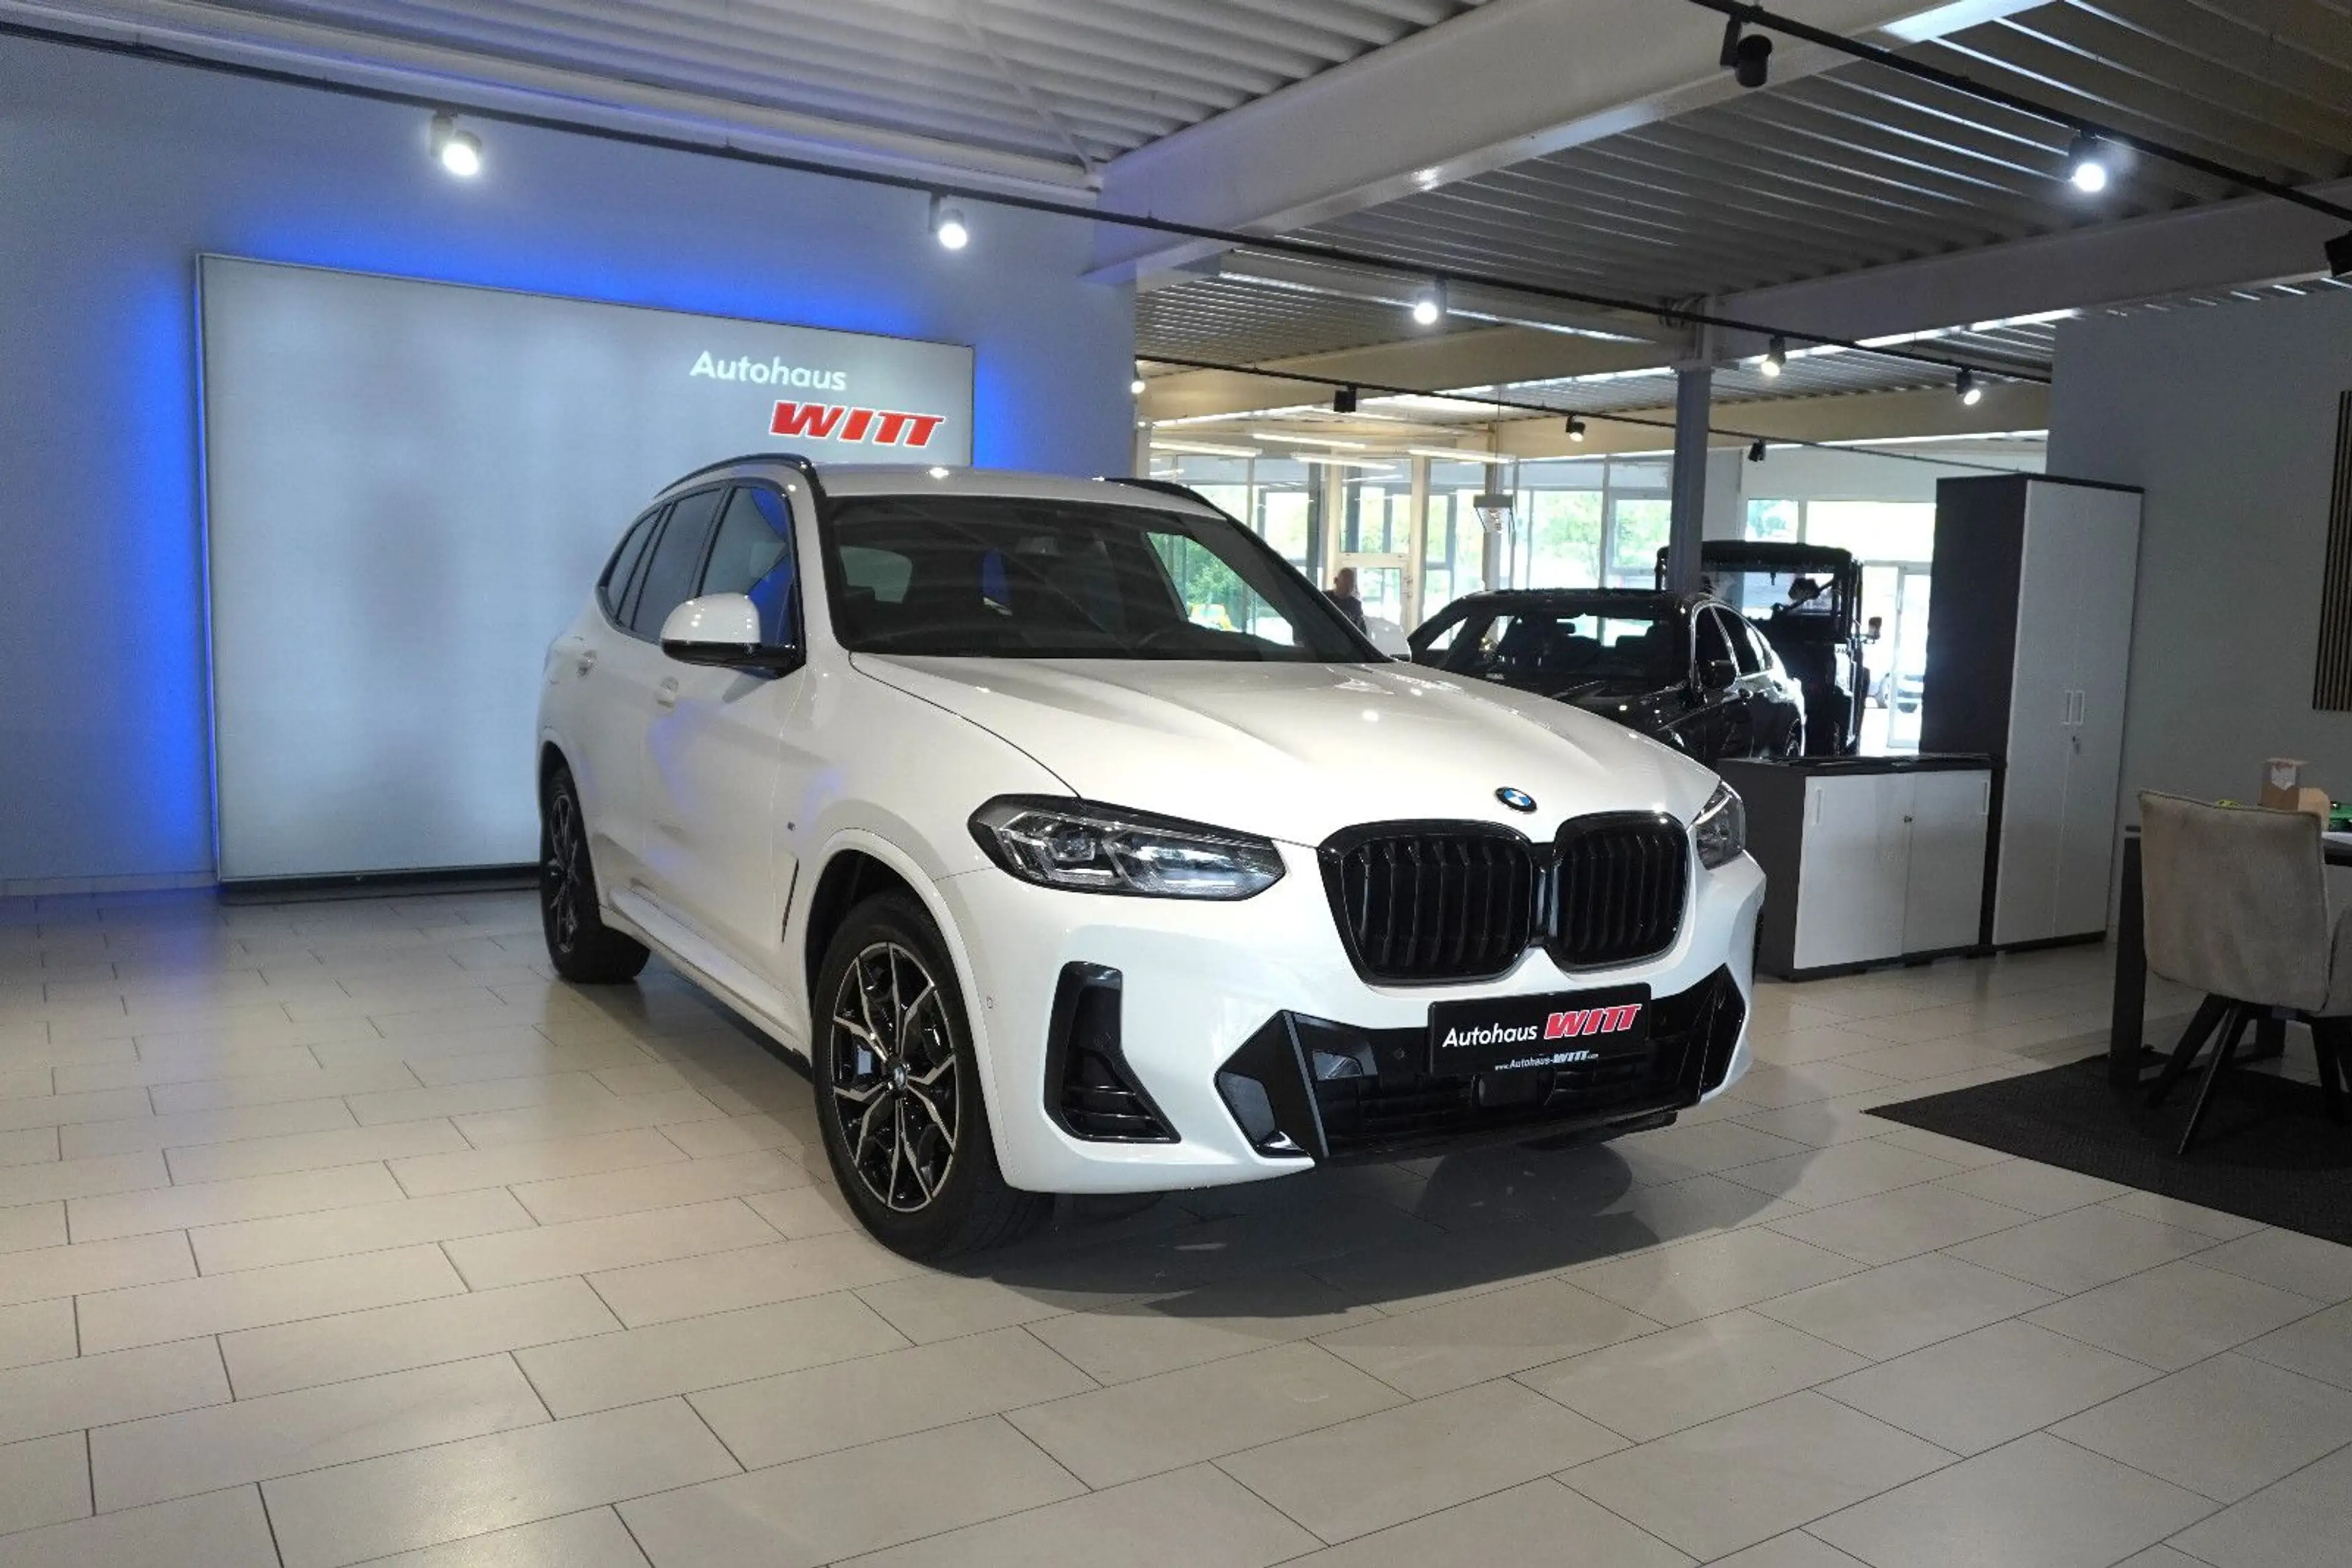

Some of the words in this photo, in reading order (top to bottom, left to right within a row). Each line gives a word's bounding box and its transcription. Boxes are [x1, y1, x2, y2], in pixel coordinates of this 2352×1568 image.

[690, 351, 847, 391] Autohaus
[769, 400, 945, 448] WITT
[1442, 1023, 1538, 1048] Autohaus
[1544, 1004, 1643, 1039] WITT
